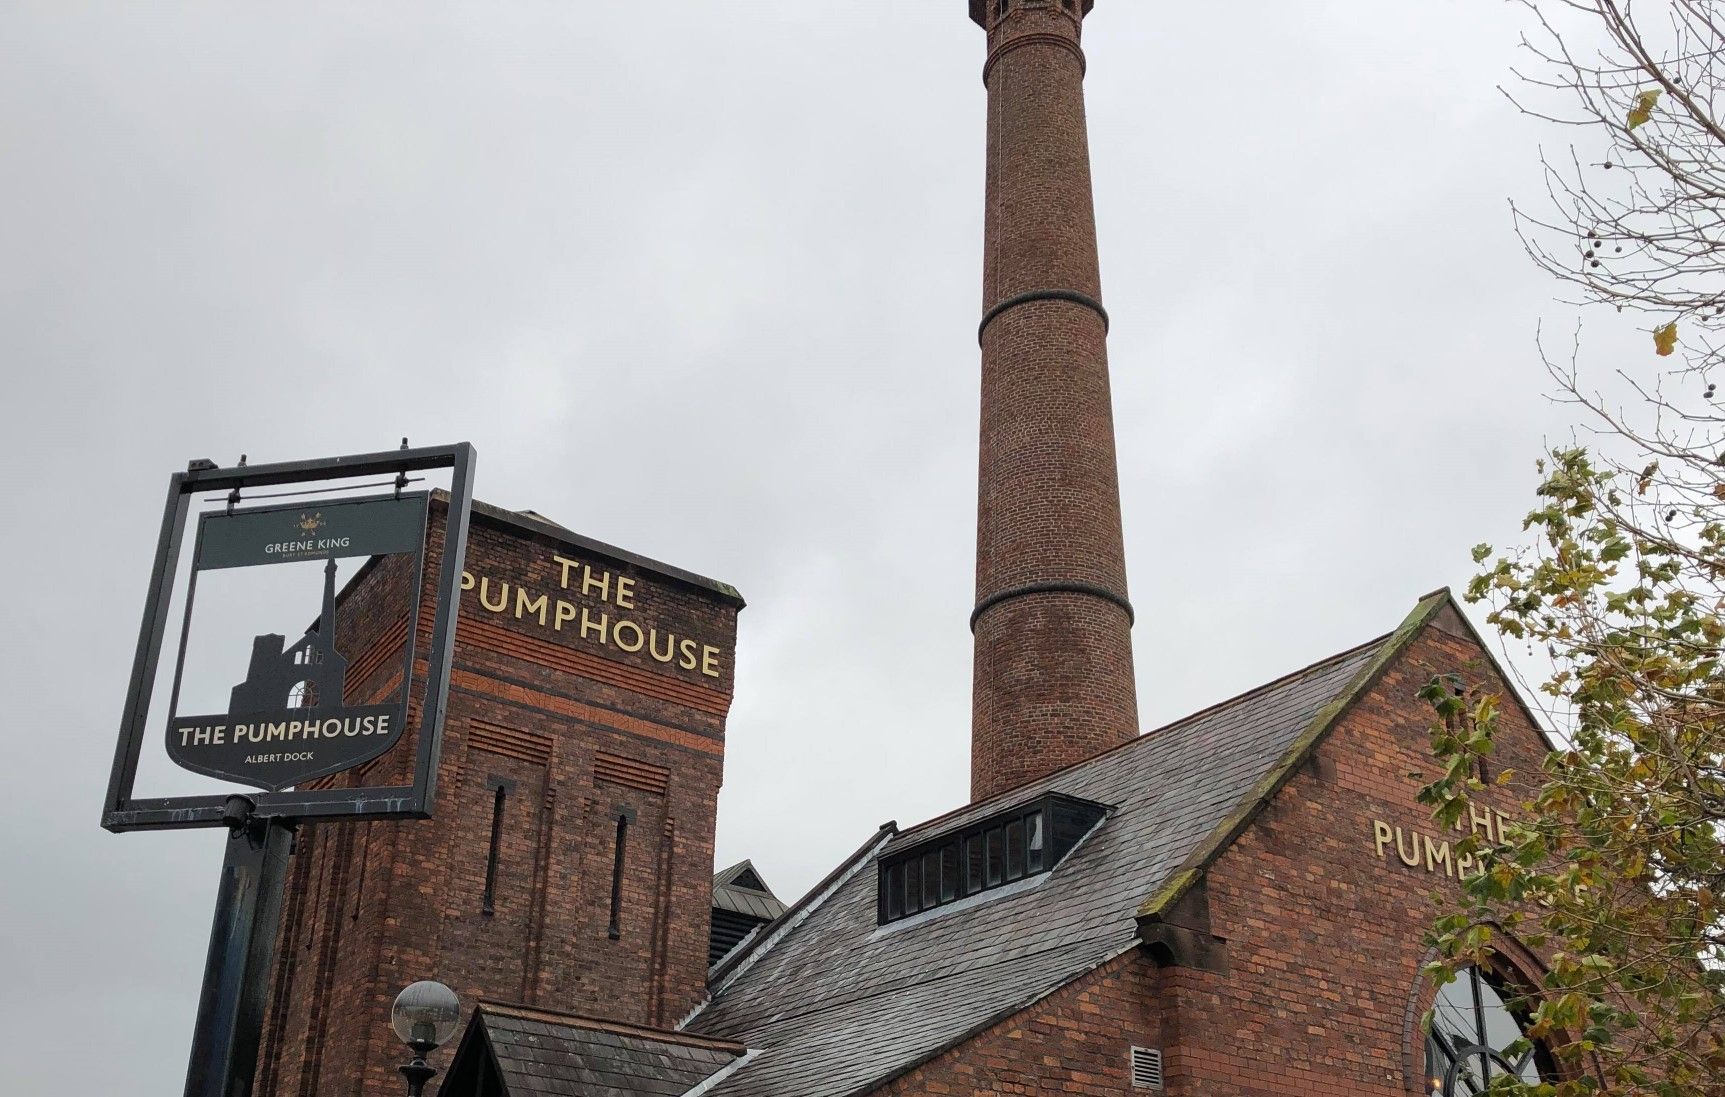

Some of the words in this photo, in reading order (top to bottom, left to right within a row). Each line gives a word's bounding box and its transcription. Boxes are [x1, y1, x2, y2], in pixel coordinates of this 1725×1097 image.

[265, 540, 313, 554] GREENE
[317, 537, 350, 549] KING
[553, 555, 636, 610] THE
[178, 725, 227, 747] THE
[233, 715, 390, 744] PUMPHOUSE
[244, 753, 282, 764] ALBERT
[284, 751, 314, 762] DOCK
[1454, 801, 1514, 847] HE
